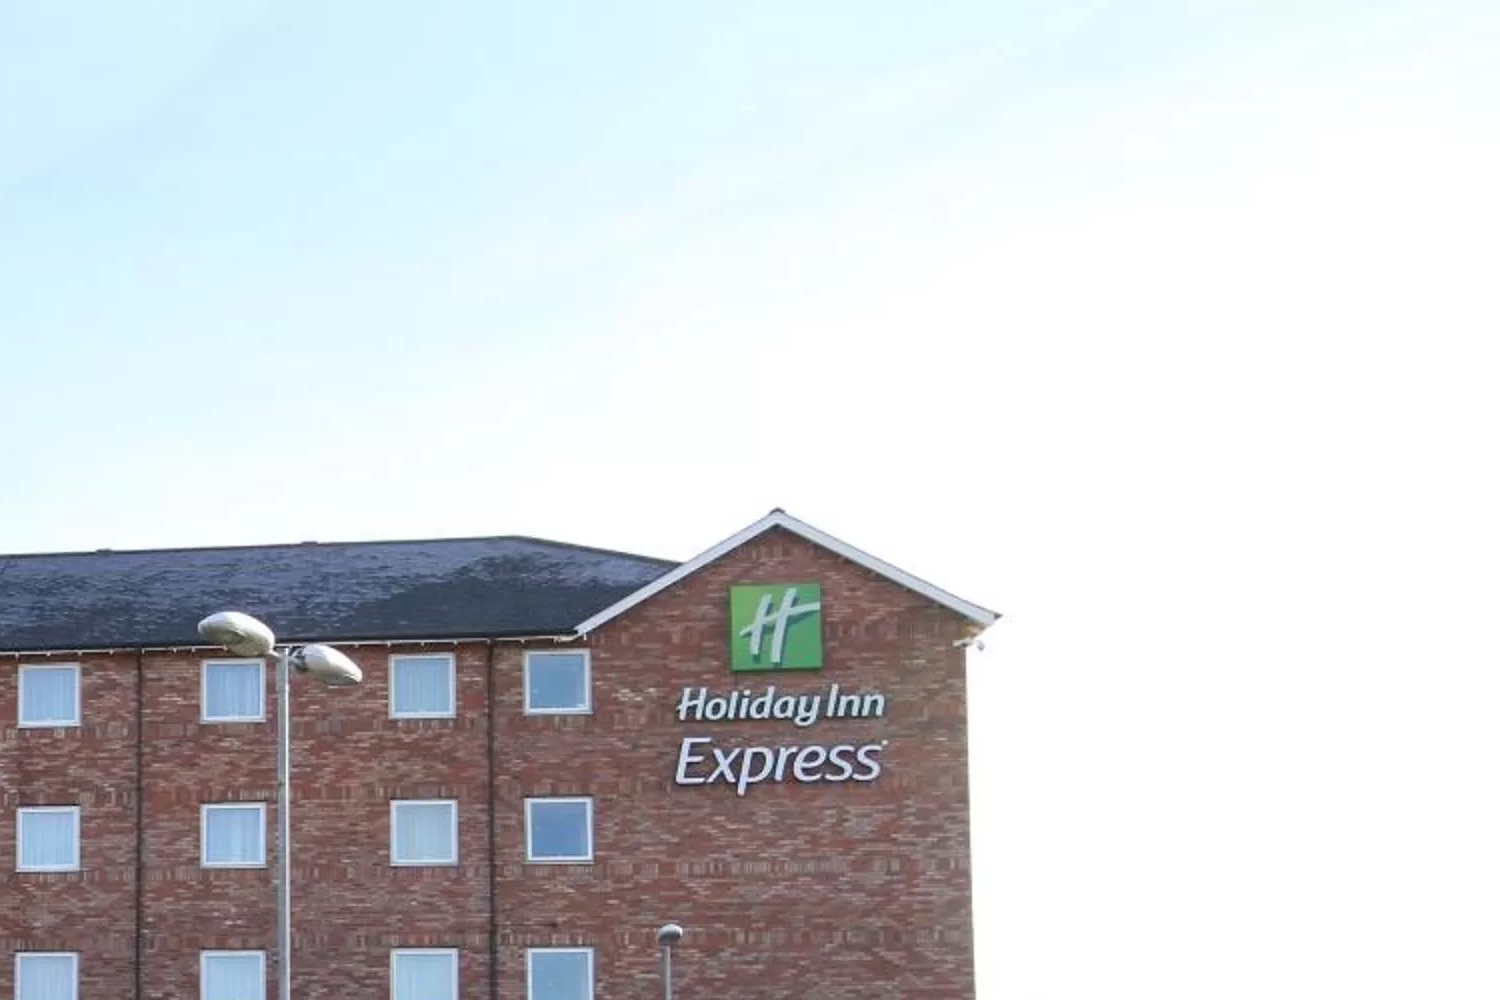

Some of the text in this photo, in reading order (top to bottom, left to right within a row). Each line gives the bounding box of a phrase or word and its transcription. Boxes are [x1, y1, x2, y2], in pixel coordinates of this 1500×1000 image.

[677, 684, 885, 726] Holiday Inn
[675, 737, 885, 796] Express
